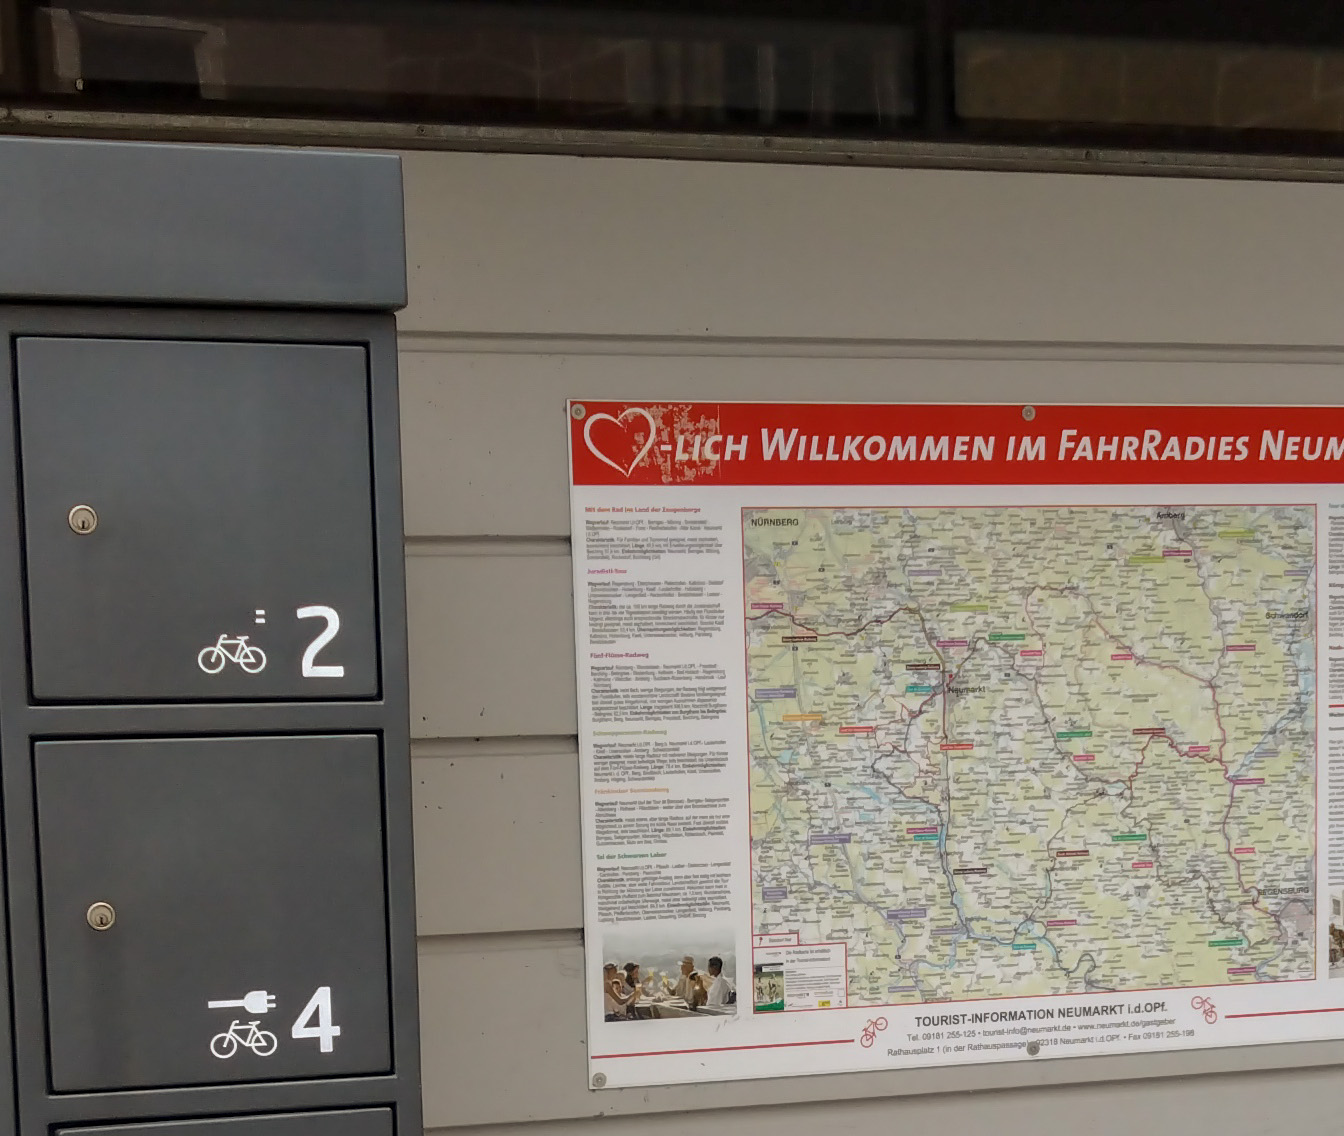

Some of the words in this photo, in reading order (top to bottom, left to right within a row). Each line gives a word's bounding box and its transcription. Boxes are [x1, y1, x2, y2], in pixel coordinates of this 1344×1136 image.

[761, 427, 995, 462] WILLKOMMEN
[1006, 435, 1047, 461] IM
[751, 517, 799, 527] NÜRNBERG
[1156, 511, 1186, 521] Amberg
[295, 605, 345, 678] 2
[947, 685, 986, 694] Neumarkt
[291, 986, 341, 1053] 4
[914, 1008, 1055, 1027] TOURIST-INFORMATION
[1057, 1004, 1125, 1019] NEUMARKT
[887, 1046, 935, 1057] Rathausplatz
[953, 1044, 965, 1053] der
[1059, 1036, 1094, 1046] Neumarkt
[1128, 1033, 1141, 1041] Fax
[922, 1031, 944, 1041] 09181
